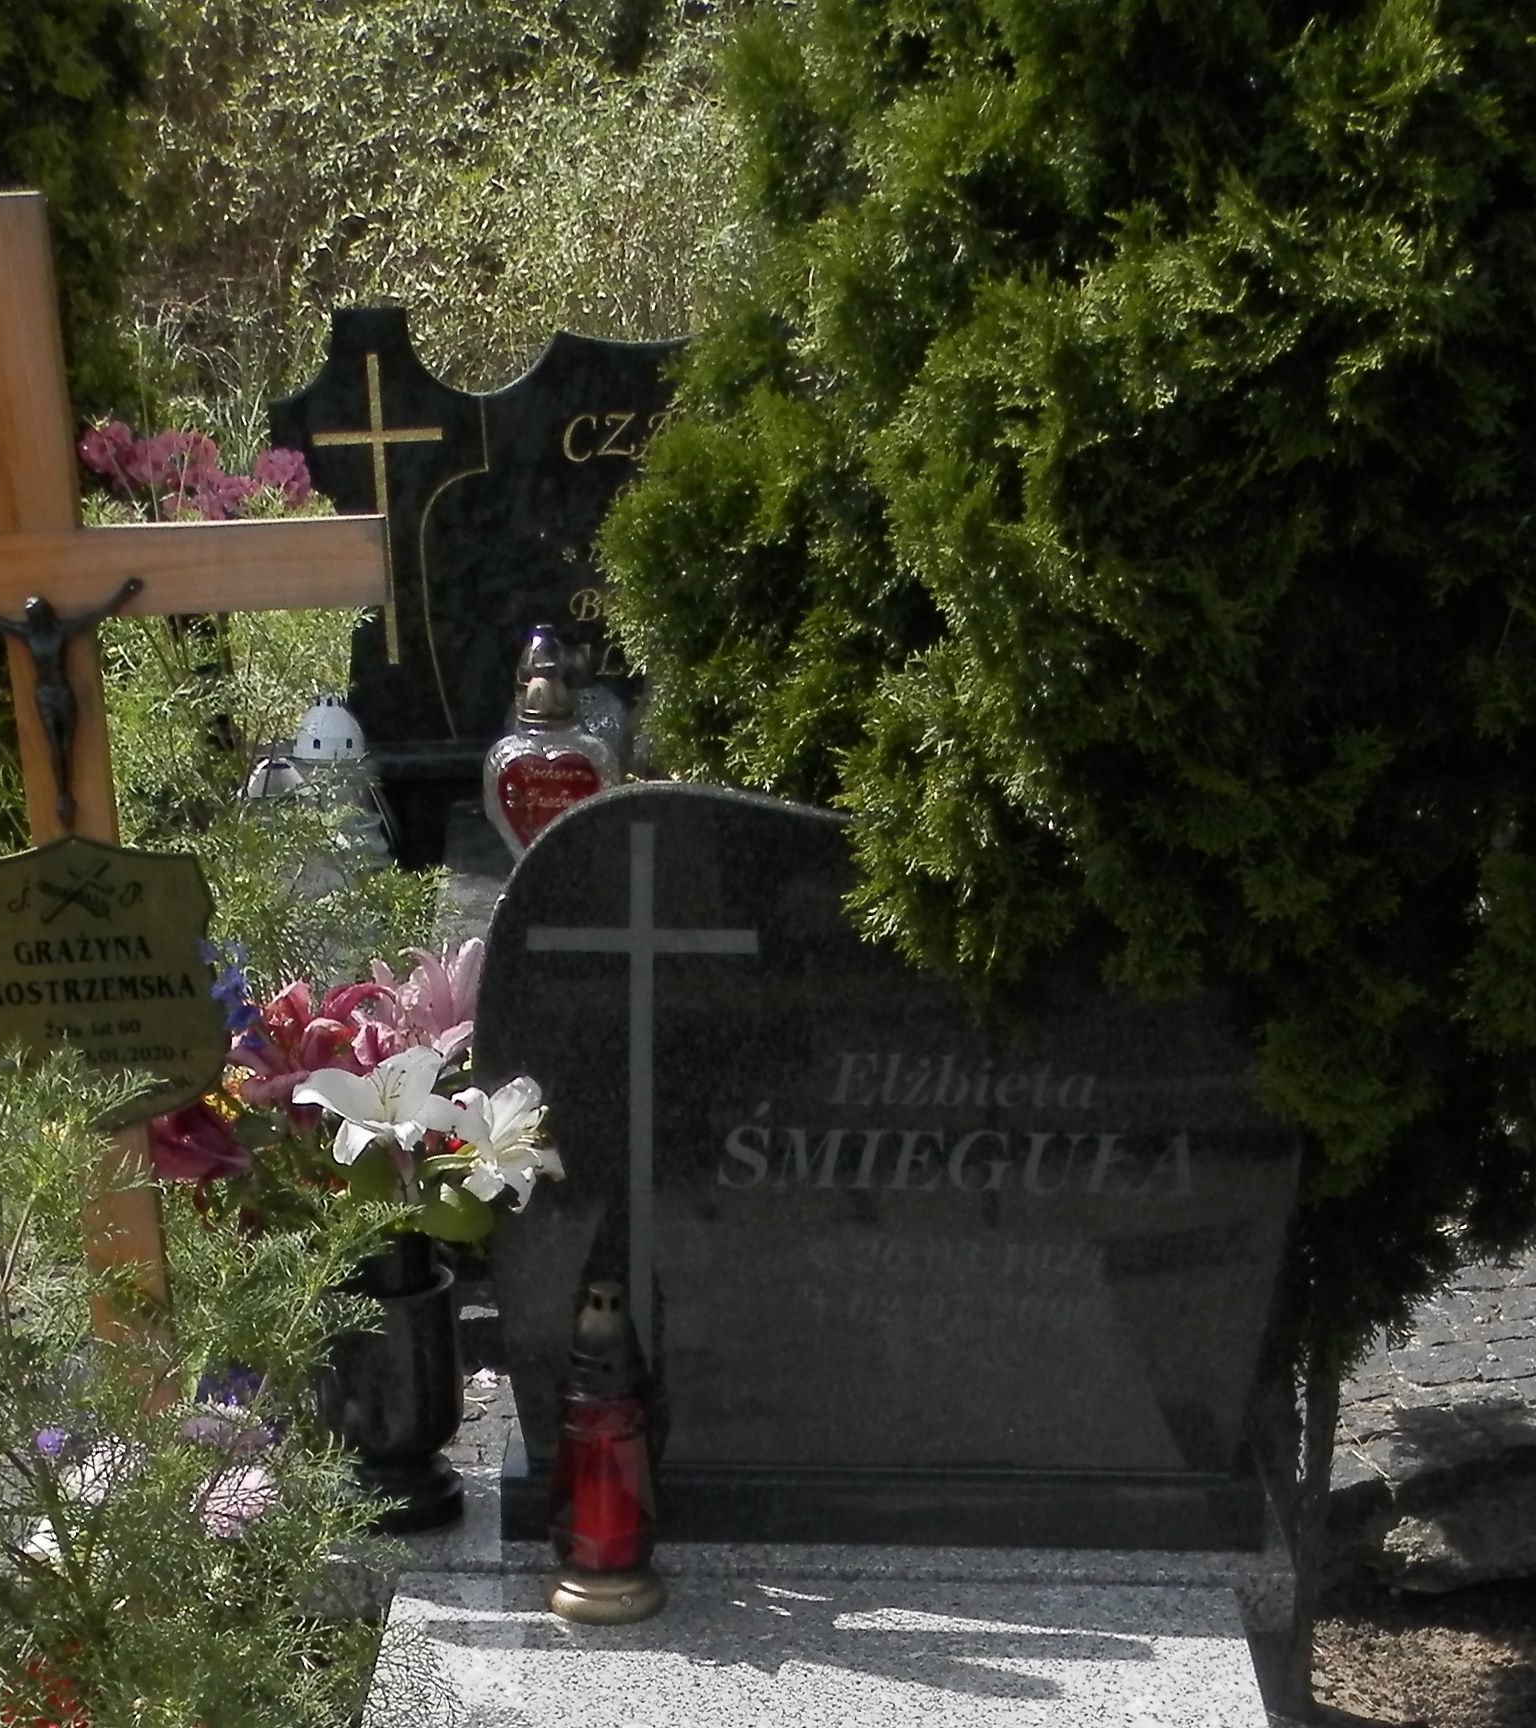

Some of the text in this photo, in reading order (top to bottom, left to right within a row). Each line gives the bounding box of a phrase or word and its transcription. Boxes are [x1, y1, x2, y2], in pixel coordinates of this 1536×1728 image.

[13, 934, 152, 966] GRAŻYNA
[829, 1051, 1098, 1110] Elżbieta
[716, 1102, 1198, 1196] ŚMIEGUŁA
